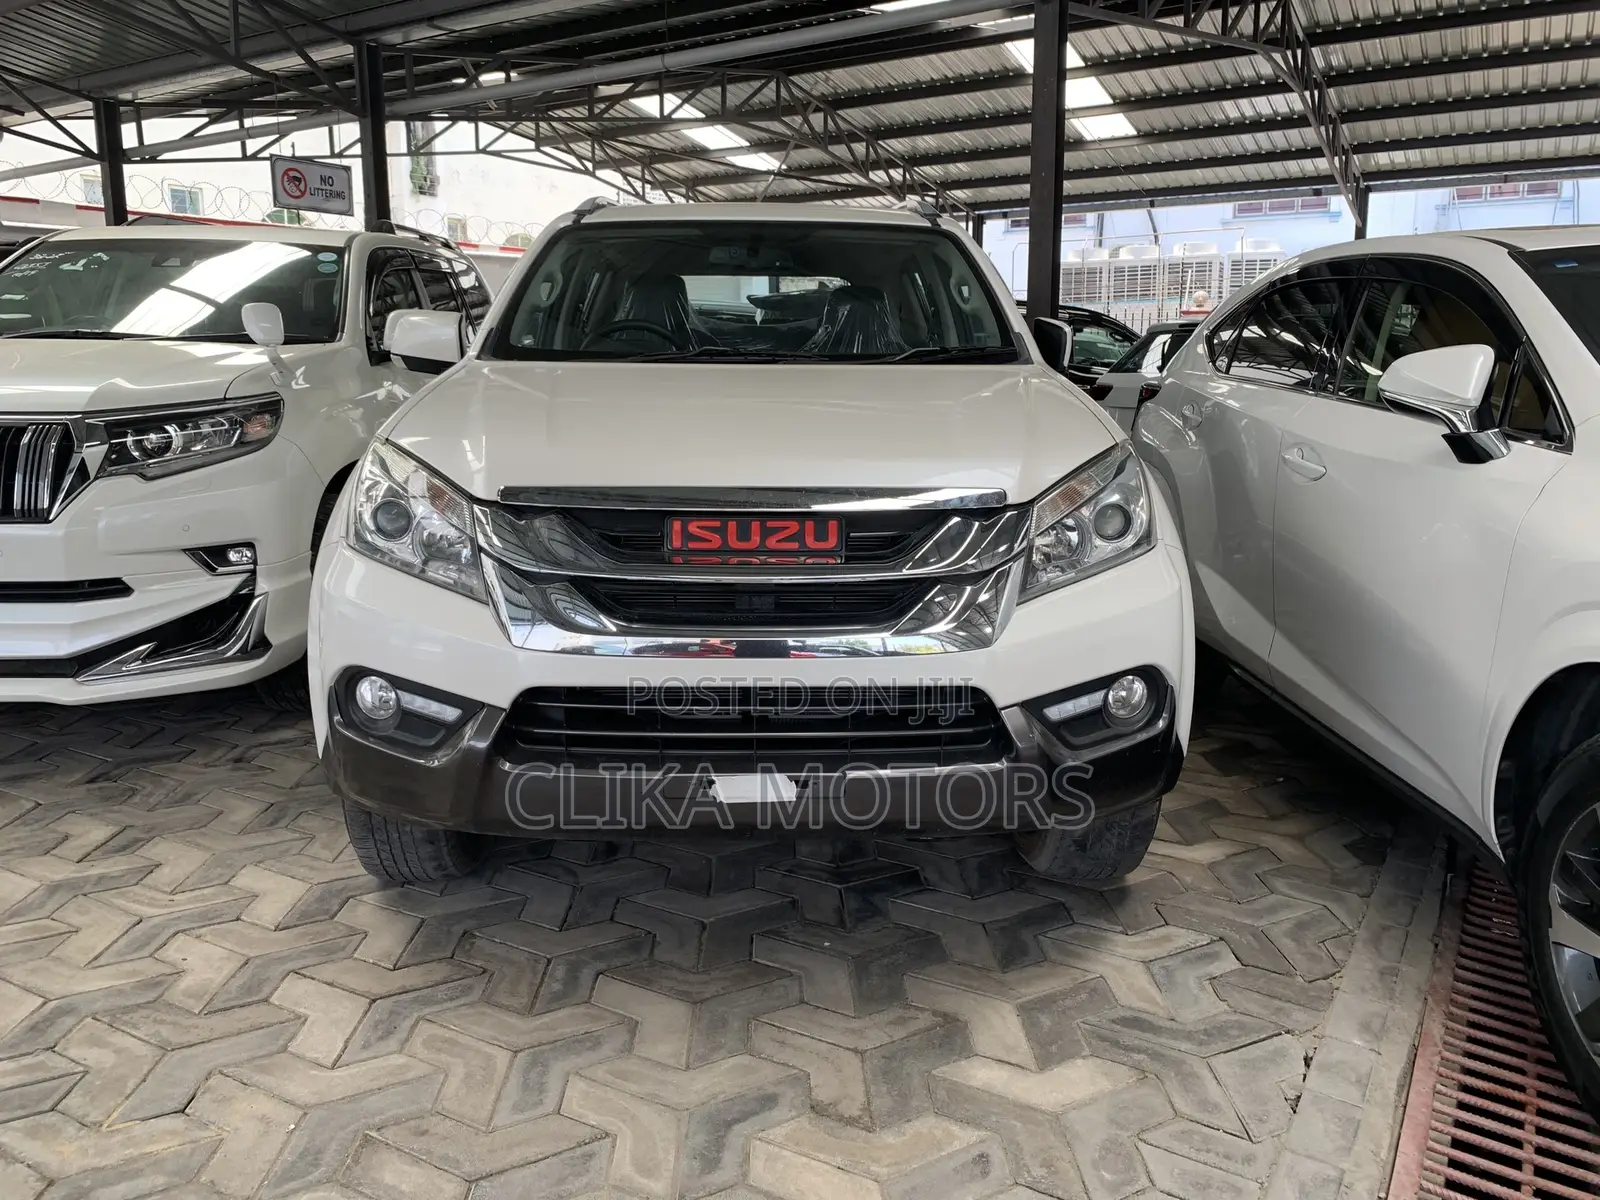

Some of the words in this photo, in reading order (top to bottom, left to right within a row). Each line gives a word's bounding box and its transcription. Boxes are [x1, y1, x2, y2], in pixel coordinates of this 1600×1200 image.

[320, 174, 334, 187] NO
[309, 187, 346, 200] LITTERING
[671, 519, 838, 549] ISUZU
